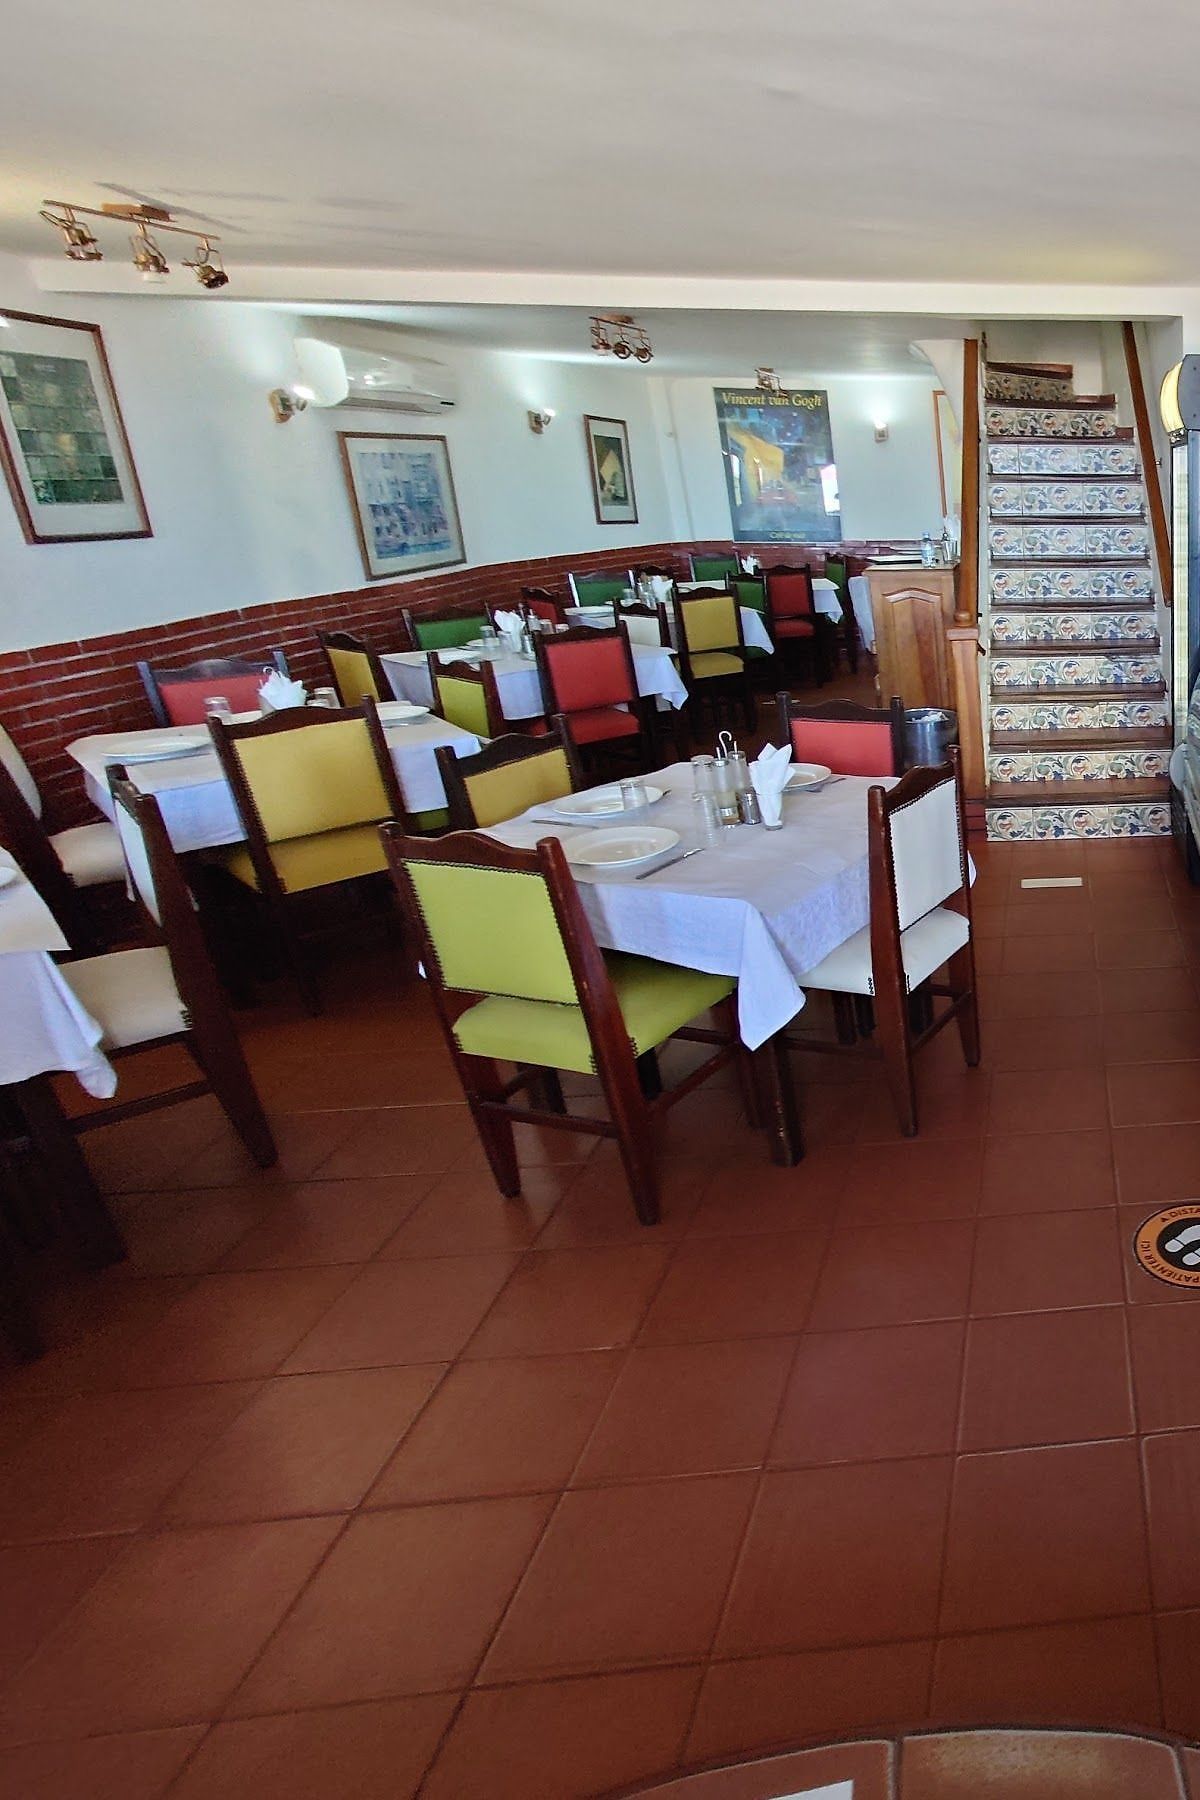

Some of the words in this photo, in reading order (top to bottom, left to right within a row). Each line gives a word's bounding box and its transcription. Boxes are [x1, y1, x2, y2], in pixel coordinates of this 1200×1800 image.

[722, 391, 765, 405] Vincent
[768, 397, 789, 406] van
[792, 394, 822, 410] Gogh
[1140, 1240, 1151, 1252] ICI
[1144, 1254, 1200, 1283] PATIENTER
